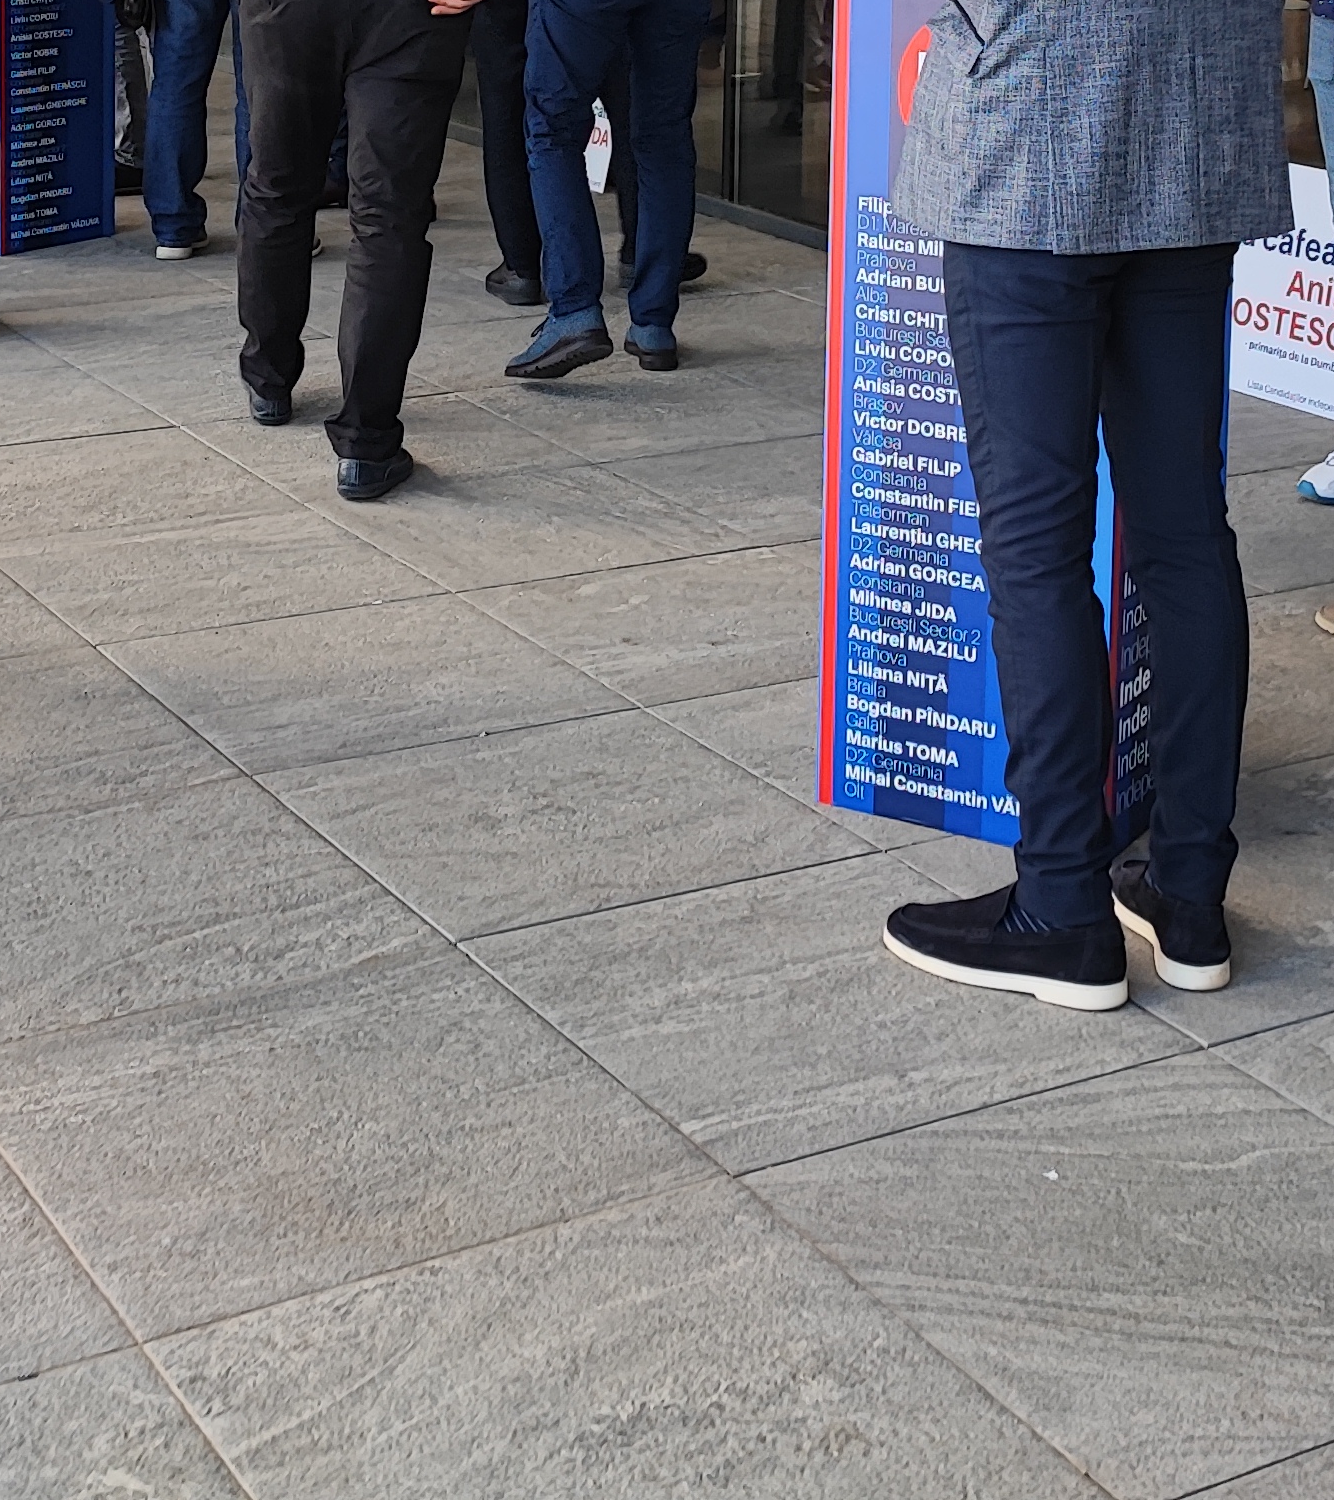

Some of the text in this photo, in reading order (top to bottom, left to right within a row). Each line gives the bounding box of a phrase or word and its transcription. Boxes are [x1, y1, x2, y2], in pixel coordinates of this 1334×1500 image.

[856, 232, 915, 254] Raluca
[856, 250, 916, 273] Prahova
[855, 268, 913, 291] Adrian
[855, 286, 889, 305] Alba
[855, 304, 900, 324] Cristi
[854, 339, 896, 360] Liviu
[1288, 351, 1300, 362] de
[853, 376, 905, 397] Anisia
[881, 362, 953, 386] Germania
[1247, 380, 1263, 391] Lista
[853, 410, 905, 433] Victor
[852, 428, 902, 451] Vâlcea
[852, 447, 962, 477] Gabriel FILIP
[851, 483, 945, 513] Constantin
[851, 500, 930, 528] Teleorman
[877, 540, 949, 567] Germania
[850, 553, 986, 592] Adrian GORCEA
[849, 589, 957, 622] Mihnea JIDA
[848, 624, 977, 663] Andrei MAZILU
[919, 619, 968, 642] Sector
[970, 629, 981, 646] 2
[848, 641, 907, 667] Prahova
[848, 659, 903, 684] Liliana
[846, 694, 996, 739] Bogdan PÎNDARU
[846, 729, 959, 768] Marius TOMA
[872, 753, 943, 782] Germania
[844, 782, 864, 799] Olt
[845, 764, 890, 788] Mihai
[893, 776, 988, 810] Constantin
